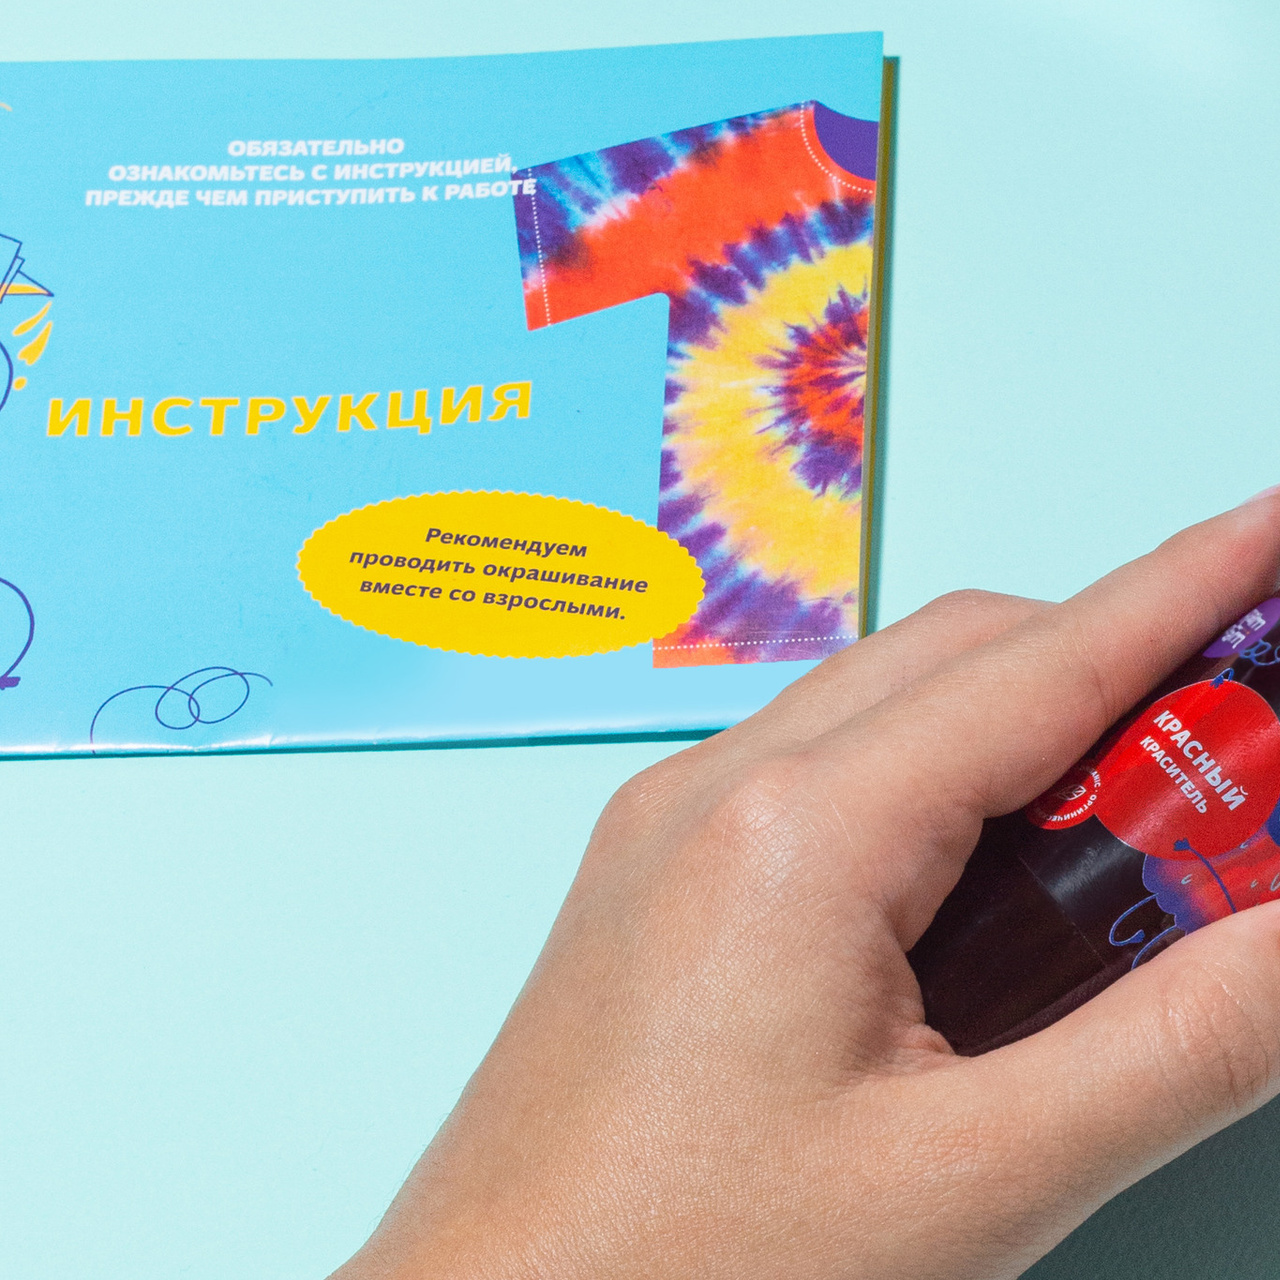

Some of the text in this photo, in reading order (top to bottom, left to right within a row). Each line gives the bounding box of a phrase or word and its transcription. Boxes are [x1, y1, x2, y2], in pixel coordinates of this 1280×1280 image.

[108, 153, 519, 182] ОЗНАКОМЬТЕСЬ С ИНСТРУКЦИЕЙ,
[227, 138, 405, 157] ОБЯЗАТЕЛЬНО
[85, 177, 538, 209] ПРЕЖДЕ ЧЕМ ПРИСТУПИТЬ К РАБОТЕ
[46, 381, 534, 438] ИНСТРУКЦИЯ
[425, 527, 588, 558] Рекомендуем
[349, 551, 649, 594] проводить окрашивание
[359, 579, 627, 620] вместе со взрослыми.
[1139, 736, 1207, 814] КРАСИТЕЛЬ
[1153, 710, 1248, 811] КРАСНЫЙ
